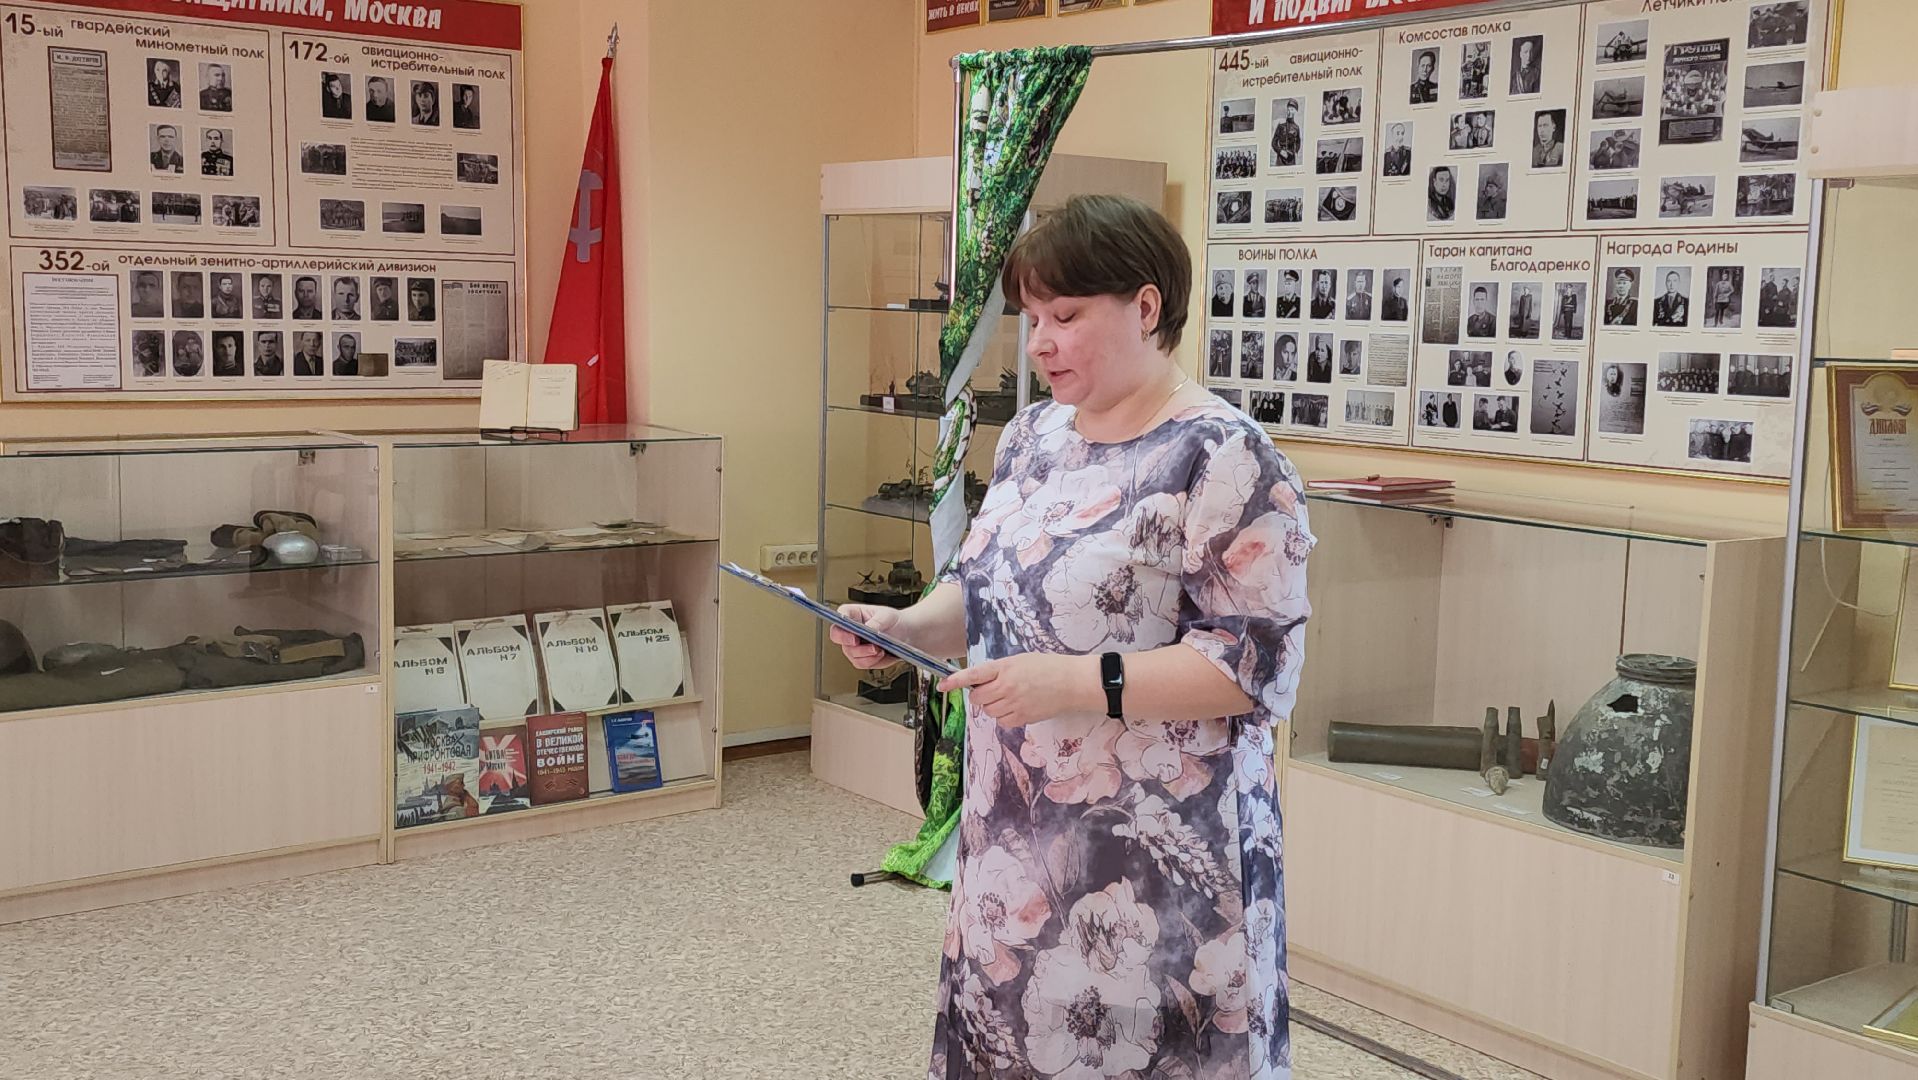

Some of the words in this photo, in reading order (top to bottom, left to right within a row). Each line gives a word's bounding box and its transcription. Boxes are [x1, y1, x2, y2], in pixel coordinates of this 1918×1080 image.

[5, 12, 63, 38] 15-ый
[71, 18, 170, 37] гвардейский
[1399, 25, 1468, 44] Комсостав
[1471, 20, 1512, 35] полка
[136, 38, 228, 55] минометный
[232, 47, 264, 58] полк
[289, 40, 349, 64] 172-ой
[362, 45, 444, 62] авиационно-
[1219, 50, 1269, 72] 445-ый
[1290, 48, 1363, 64] авиационно-
[371, 60, 474, 77] истребительный
[478, 69, 505, 79] полк
[1242, 66, 1333, 88] истребительный
[1336, 65, 1362, 77] полк
[1279, 248, 1317, 260] ПОЛКА
[1429, 245, 1466, 258] Таран
[1470, 244, 1532, 256] капитана
[1606, 242, 1672, 257] Награда
[1677, 240, 1738, 256] Родины
[39, 250, 110, 271] 352-ой
[118, 254, 197, 266] отдельный
[201, 257, 374, 271] зенитно-артиллерийский
[377, 262, 437, 272] дивизион
[1490, 258, 1590, 274] Благодаренко
[618, 628, 663, 638] АЛЬБОМ
[467, 644, 520, 656] АЛЬБОМ
[546, 637, 596, 648] АЛЬБОМ
[394, 657, 448, 668] АЛЬБОМ
[545, 733, 583, 747] ВЕЛИКОЙ
[537, 753, 584, 767] ВОЙНЕ
